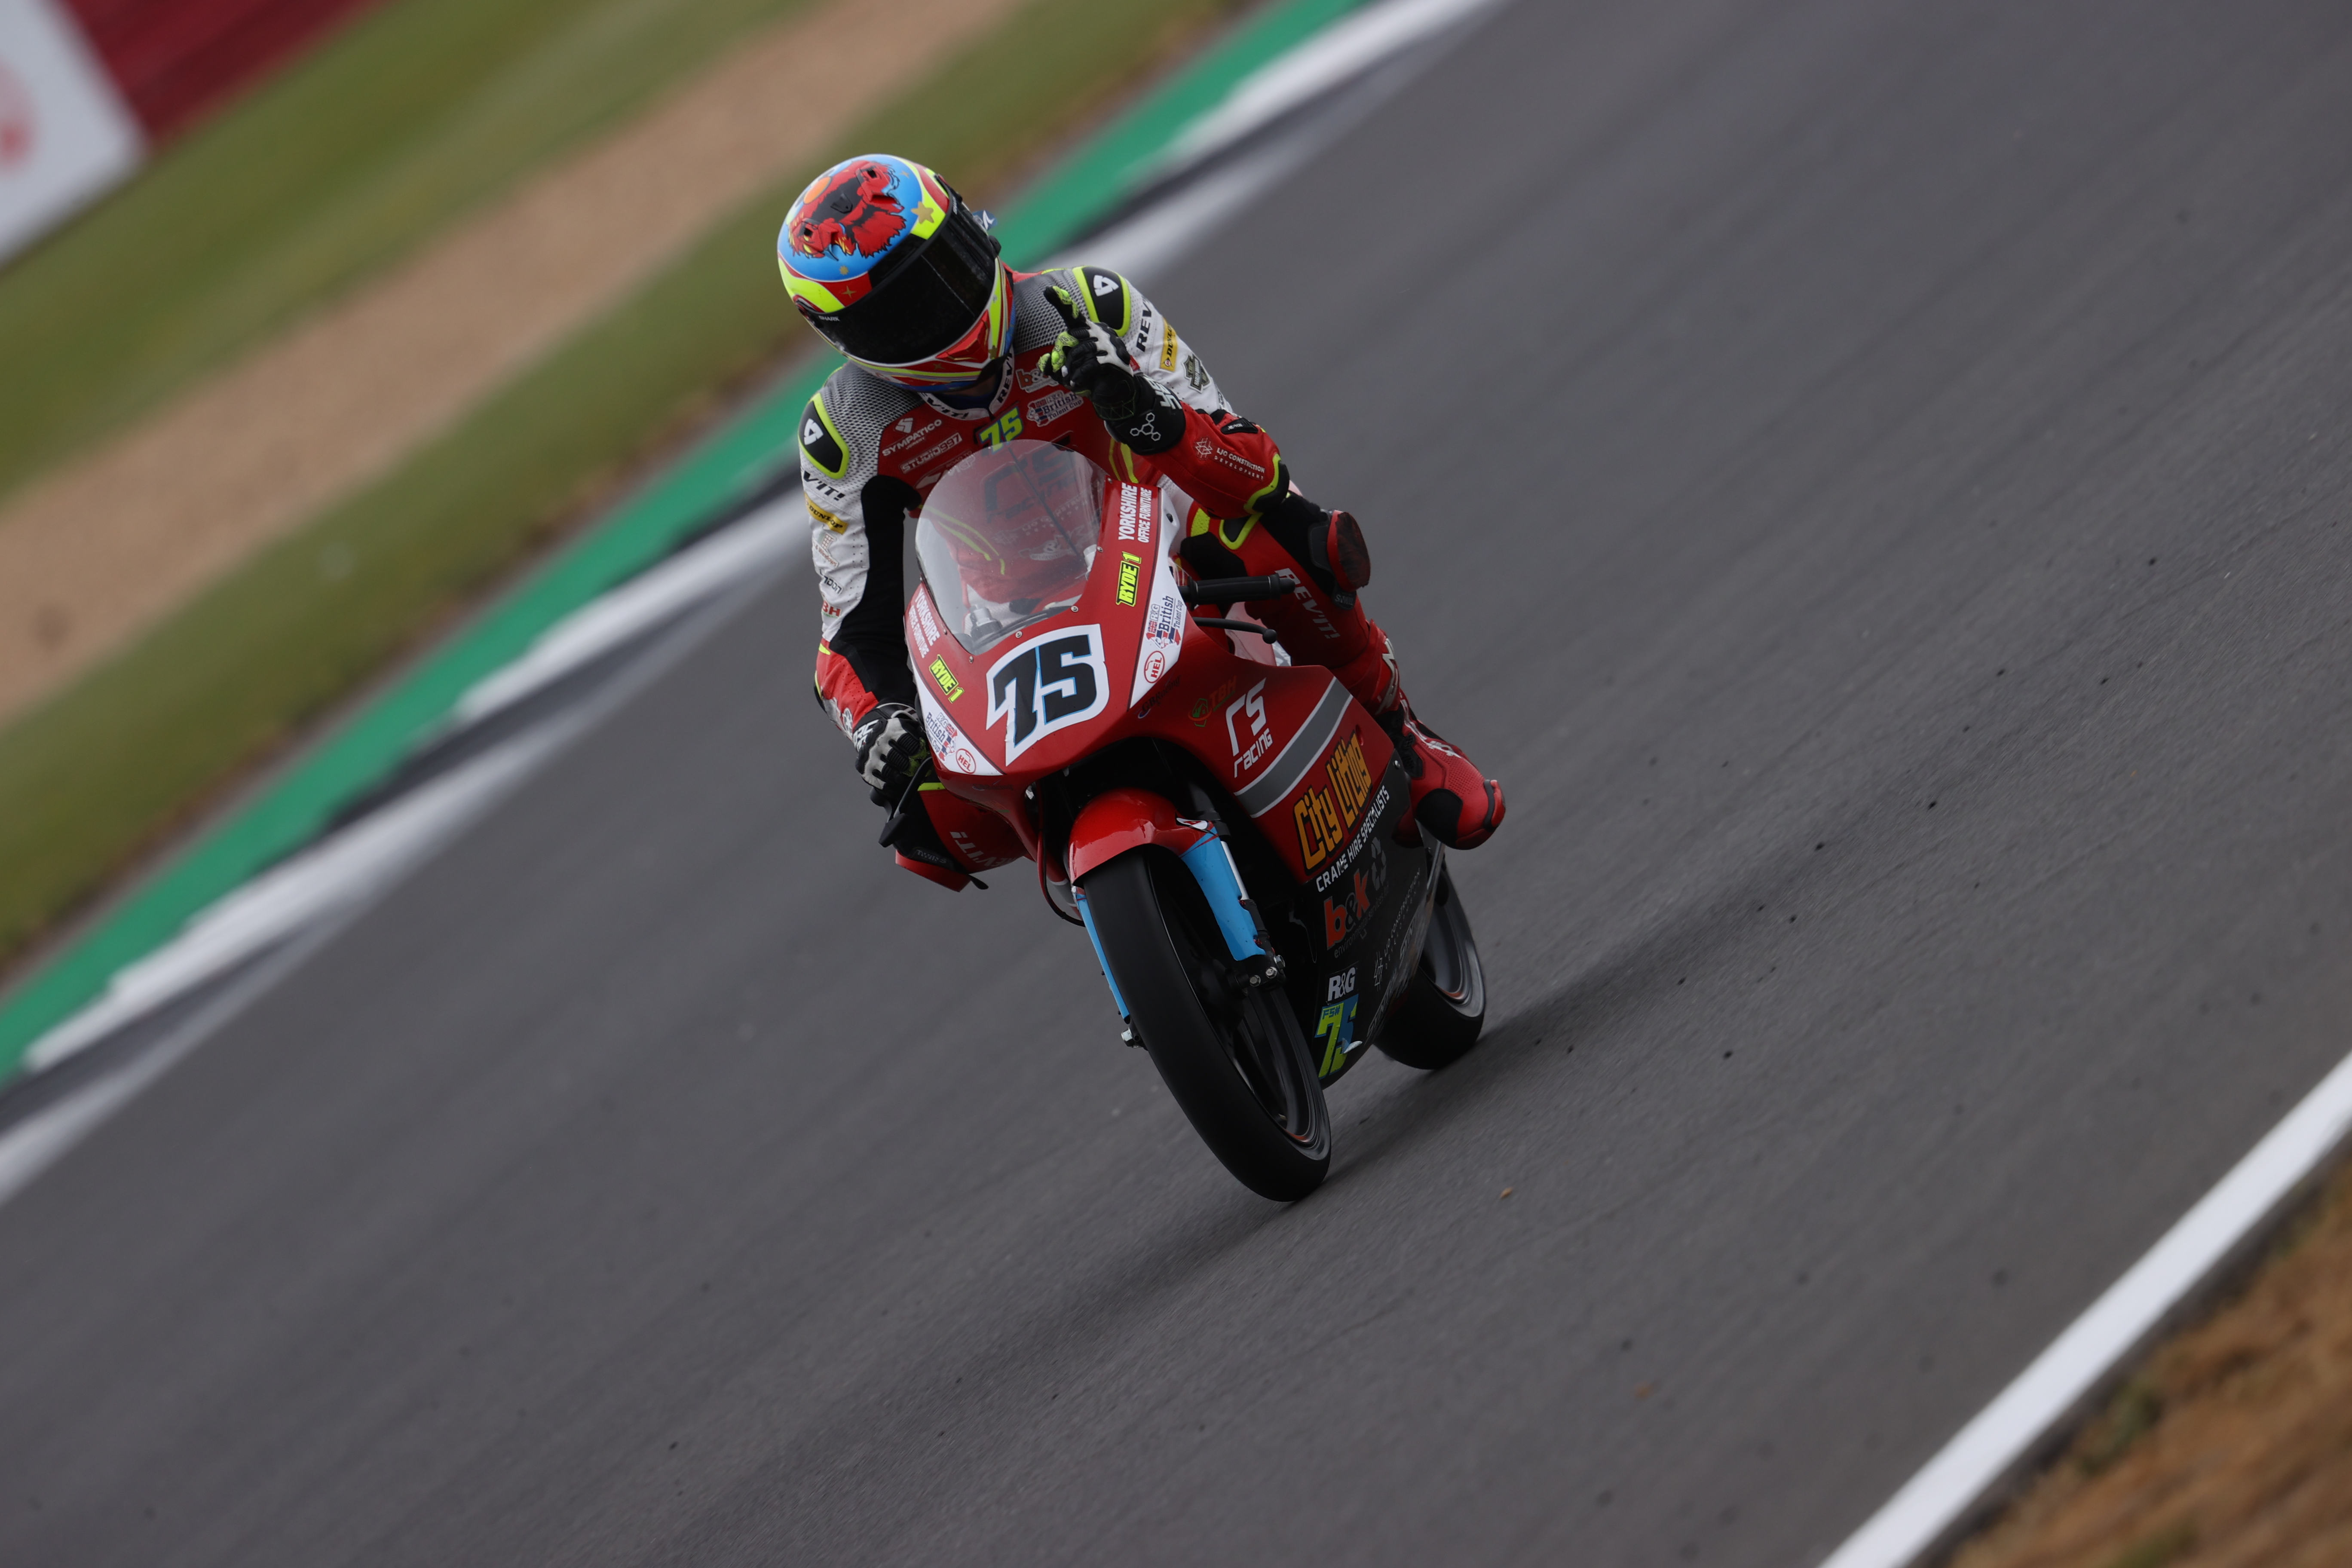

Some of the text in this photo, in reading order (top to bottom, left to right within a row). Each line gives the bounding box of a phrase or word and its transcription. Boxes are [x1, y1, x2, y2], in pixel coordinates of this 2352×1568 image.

[1042, 392, 1077, 413] British
[1048, 406, 1069, 419] Talent
[1069, 399, 1082, 407] Cup
[882, 419, 943, 456] SYMPATICO
[979, 406, 1023, 453] 75
[1216, 447, 1228, 456] LJO
[809, 505, 843, 528] DUNLOP
[1118, 482, 1138, 540] YORKSHIRE
[1137, 487, 1152, 543] OFFICE FURNITURE
[1118, 552, 1141, 605] RYDE 1
[915, 588, 941, 646] YORKSHIRE
[1159, 595, 1174, 632] British
[930, 658, 964, 703] RYDE 1
[1151, 657, 1163, 678] HEL
[992, 634, 1097, 748] 75
[925, 712, 946, 743] British
[958, 754, 971, 772] HEL
[1294, 732, 1372, 870] City Lifting
[1347, 836, 1362, 864] HIRE
[1360, 785, 1390, 843] SPECIALISTS
[1323, 868, 1371, 951] b&k
[1327, 967, 1357, 1002] R&G
